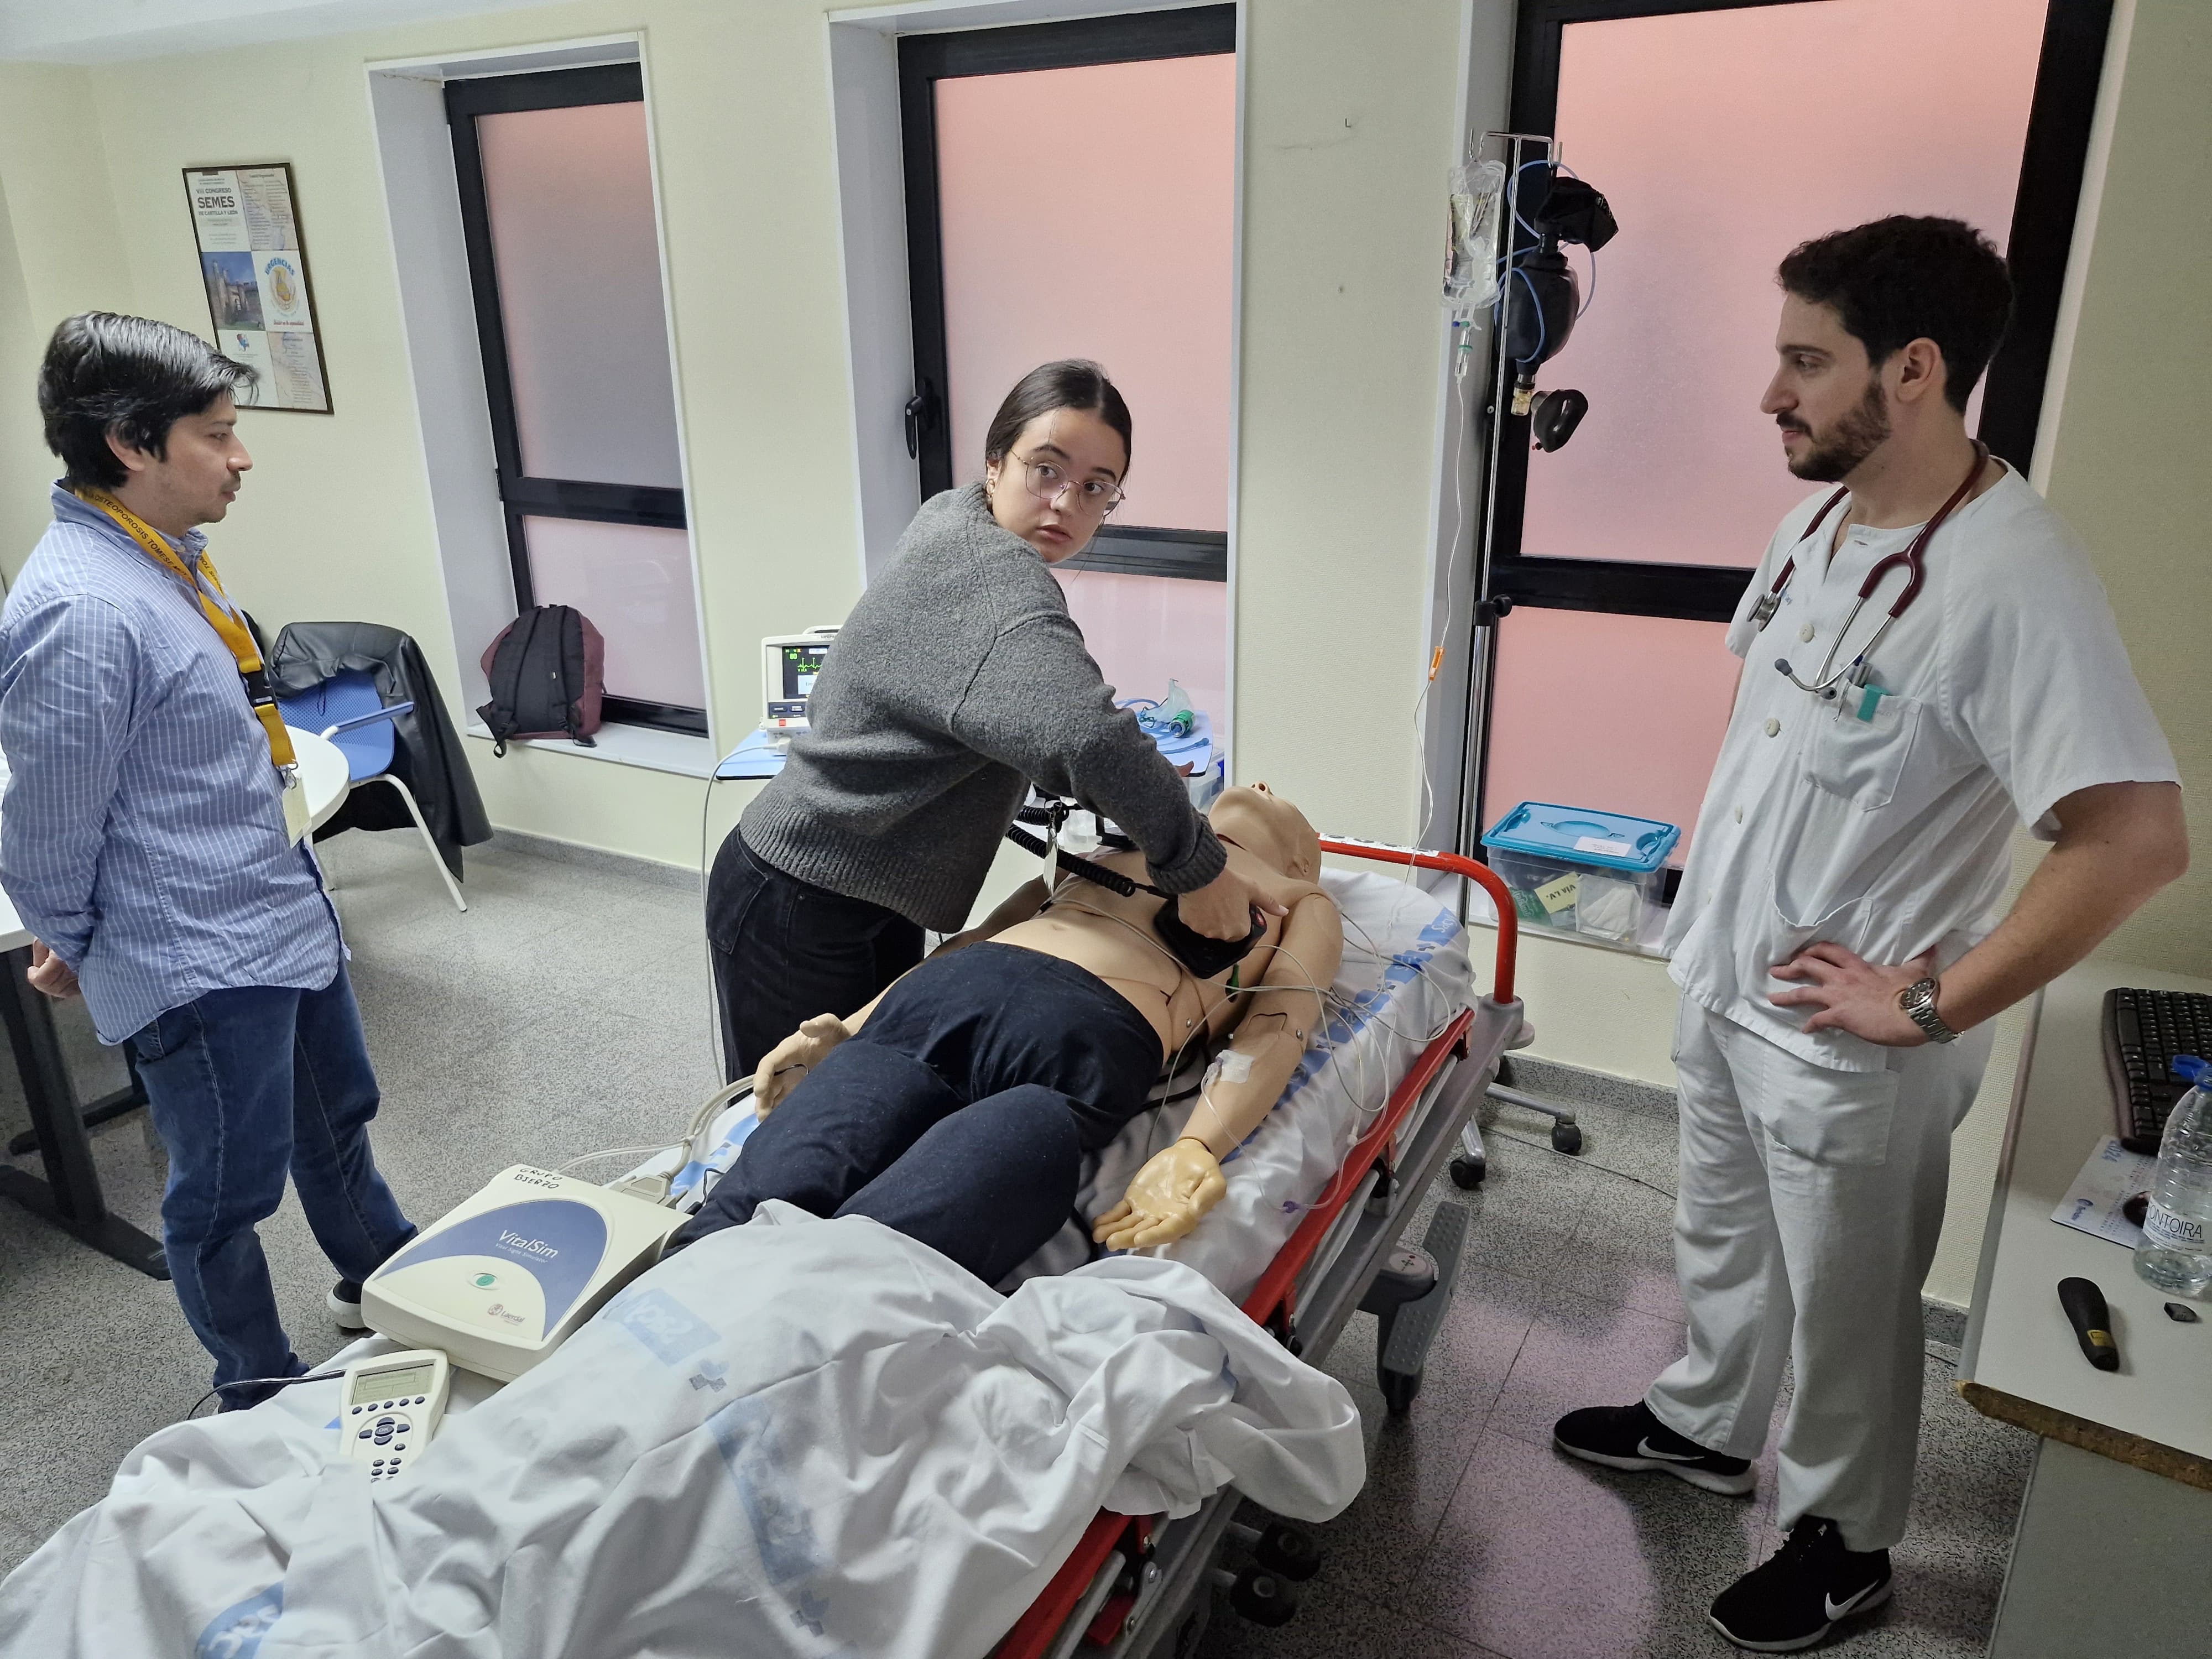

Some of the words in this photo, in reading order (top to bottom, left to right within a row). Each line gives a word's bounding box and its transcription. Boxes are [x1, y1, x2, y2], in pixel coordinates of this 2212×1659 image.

[198, 196, 235, 208] SEMES
[265, 257, 295, 275] URGENCIAS
[520, 1168, 562, 1180] GRUPO
[499, 1229, 559, 1259] VitalSim
[522, 1252, 548, 1263] Simulator
[501, 1311, 525, 1322] Laerdal
